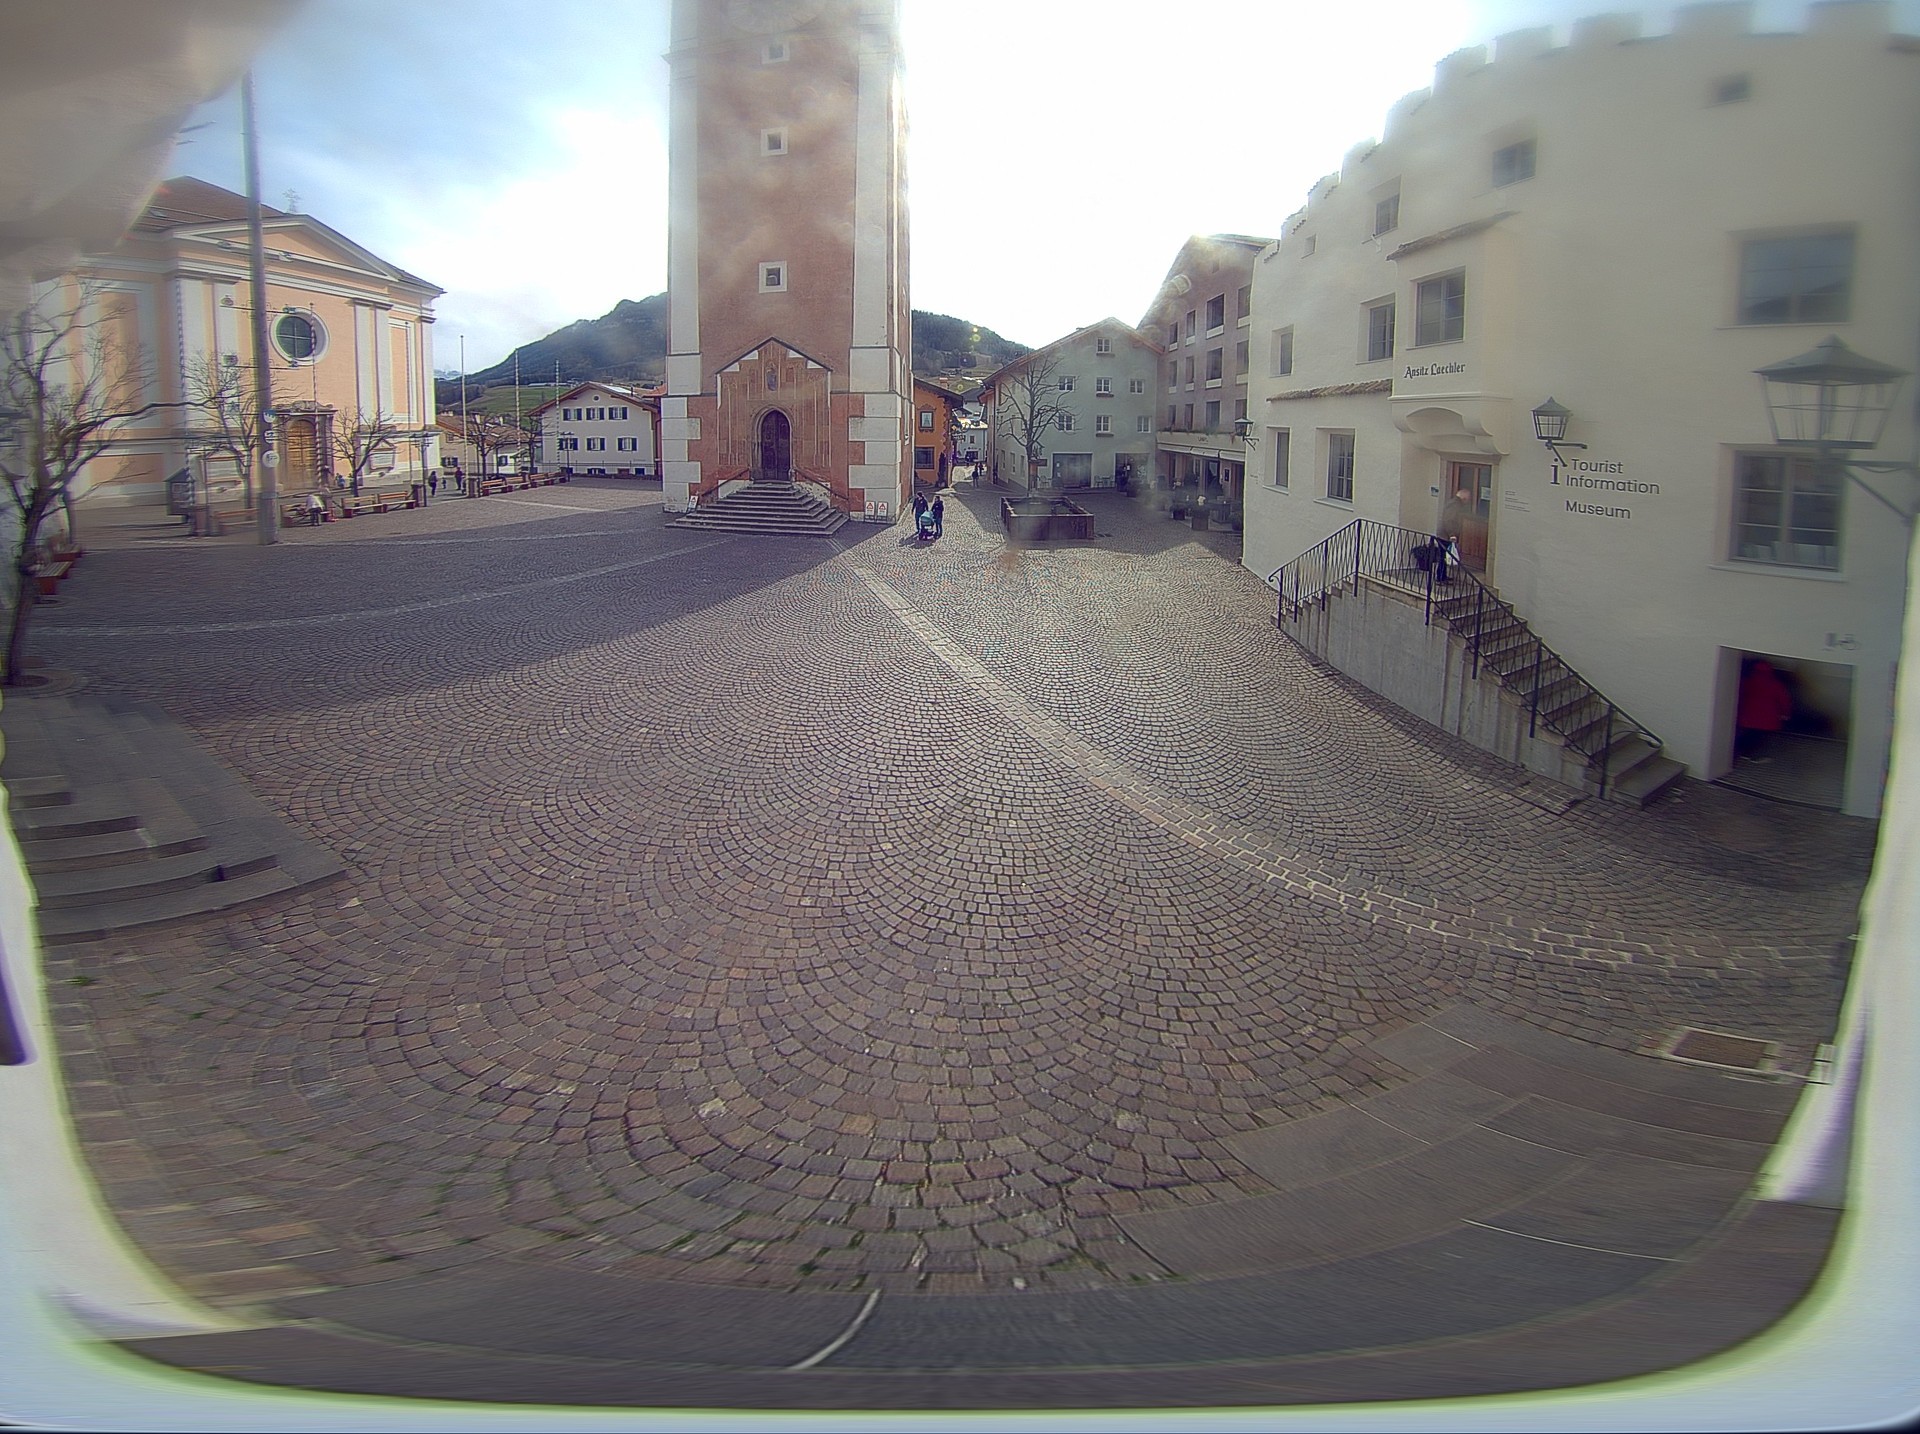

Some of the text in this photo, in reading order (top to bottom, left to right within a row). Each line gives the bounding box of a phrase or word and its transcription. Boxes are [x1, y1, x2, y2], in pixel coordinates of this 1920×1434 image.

[1404, 362, 1466, 379] Ansitz Laechler
[1571, 458, 1624, 474] Tourist
[1566, 474, 1660, 494] Information
[1566, 500, 1631, 519] Museum
